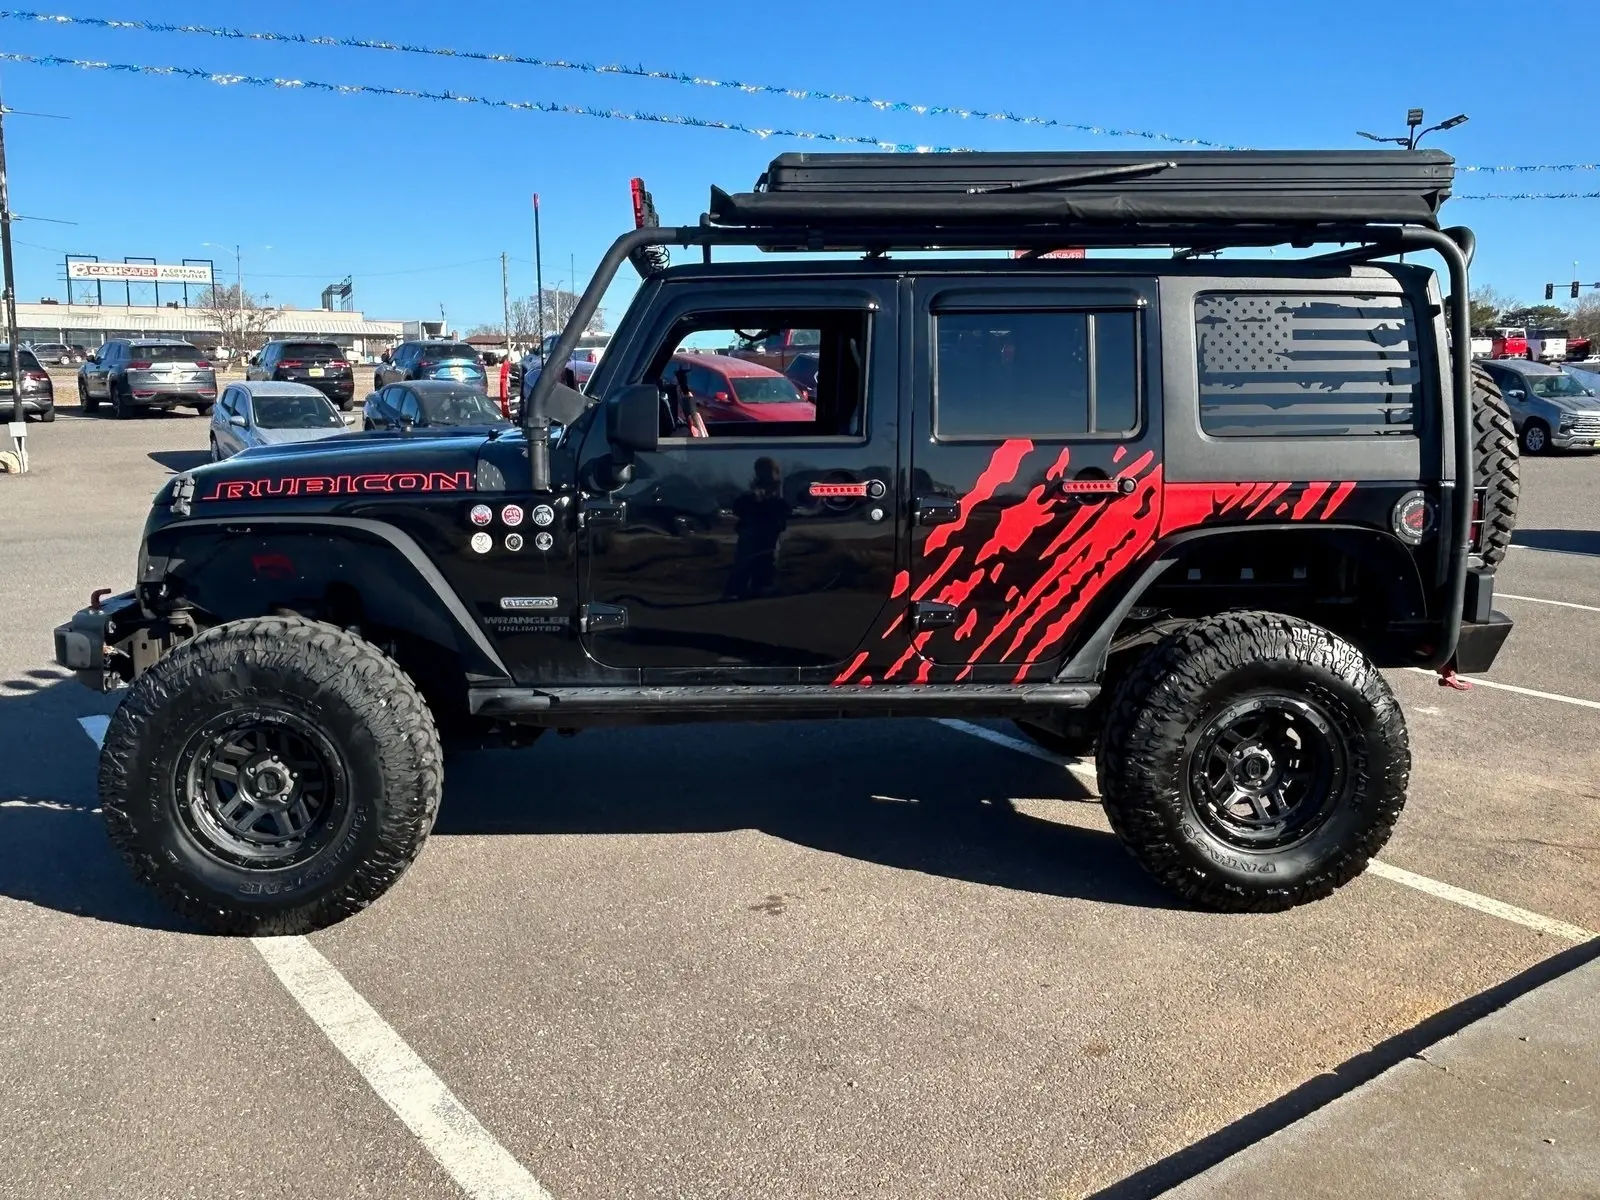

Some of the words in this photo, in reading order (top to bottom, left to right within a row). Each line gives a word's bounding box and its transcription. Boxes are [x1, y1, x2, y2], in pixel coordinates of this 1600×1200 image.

[89, 266, 155, 277] CASHSAVER
[203, 471, 474, 500] RUBICON
[484, 616, 570, 625] WRANGLER
